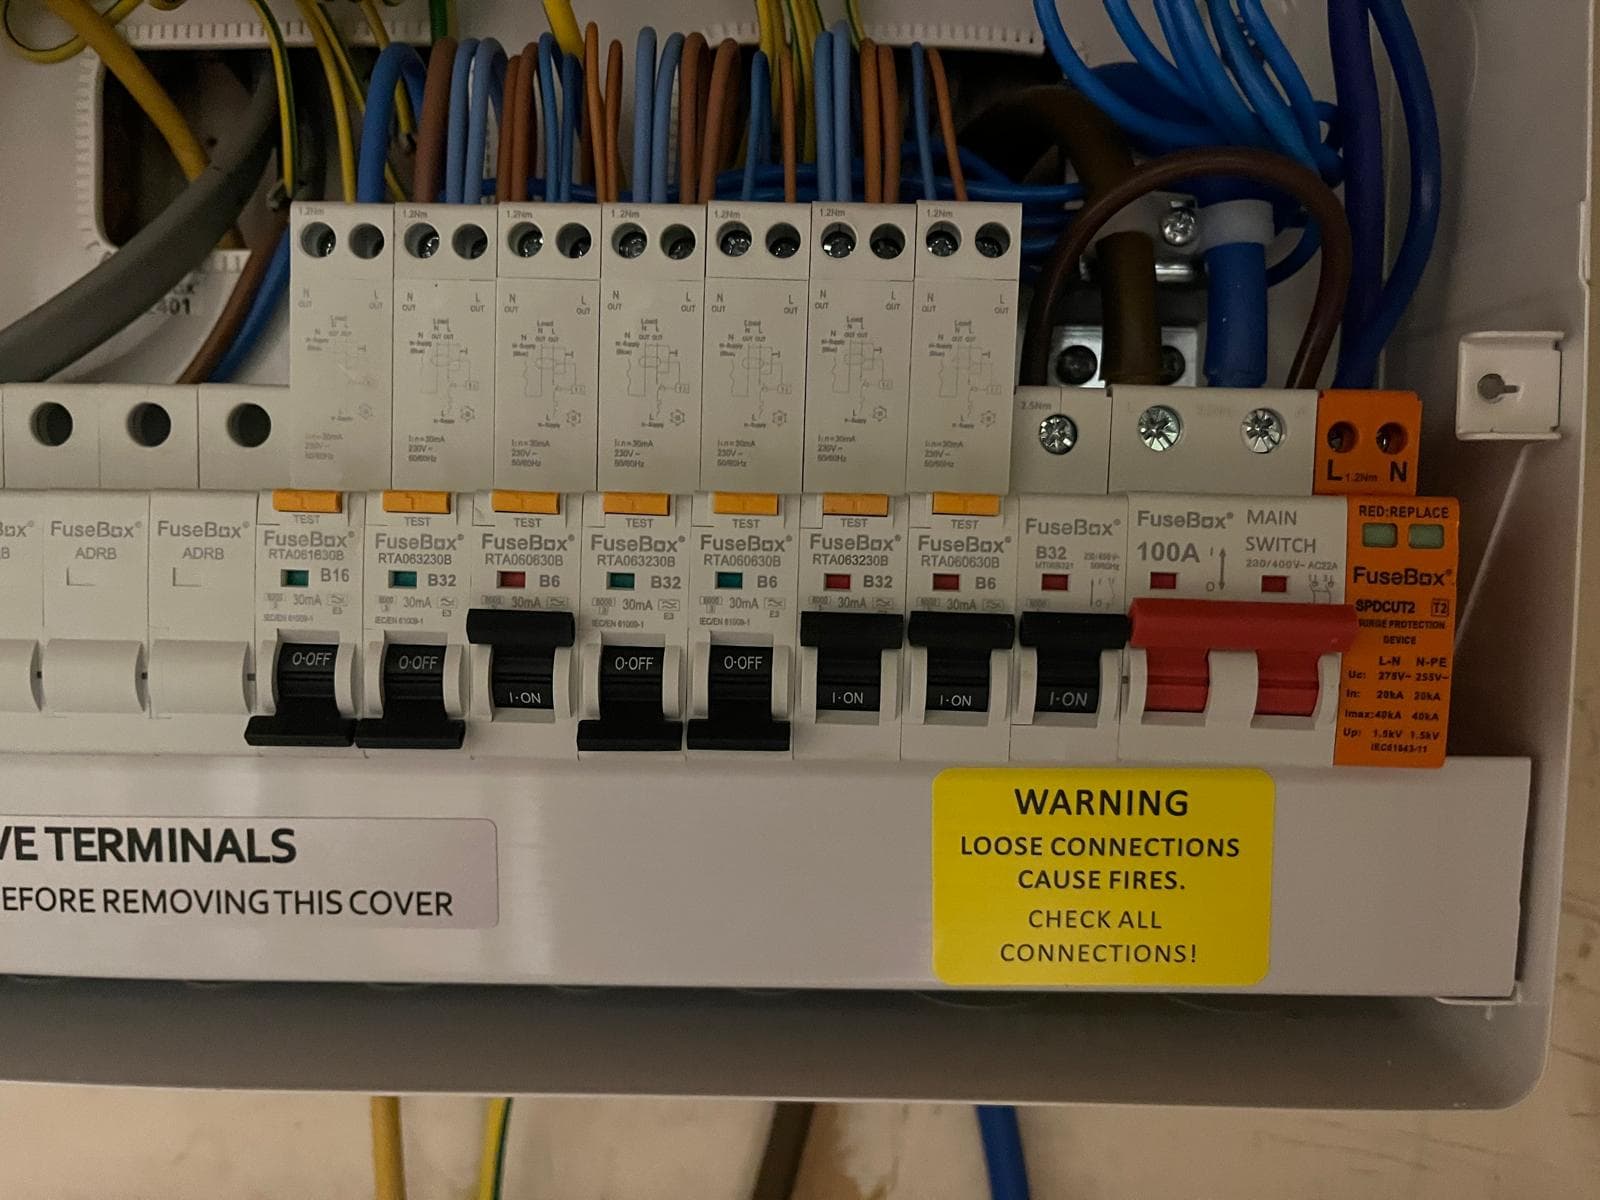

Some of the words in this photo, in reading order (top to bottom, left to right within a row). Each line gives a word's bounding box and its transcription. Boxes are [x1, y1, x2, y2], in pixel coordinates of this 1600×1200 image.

[613, 291, 620, 300] N
[686, 292, 691, 302] L
[717, 293, 724, 302] N
[788, 295, 794, 304] L
[402, 304, 416, 312] OUT
[470, 304, 485, 313] OUT
[504, 305, 519, 313] OUT
[577, 307, 591, 315] OUT
[607, 303, 622, 311] OUT
[681, 304, 696, 313] OUT
[711, 305, 726, 313] OUT
[784, 306, 798, 315] OUT
[815, 302, 829, 310] OUT
[886, 303, 900, 311] OUT
[922, 305, 936, 313] OUT
[995, 306, 1009, 315] OUT
[1327, 460, 1343, 481] L
[1390, 461, 1408, 482] N
[1247, 510, 1297, 525] MAIN
[1360, 505, 1449, 519] RED:REPLACE
[404, 517, 431, 526] TEST
[514, 518, 542, 528] TEST
[625, 518, 654, 528] TEST
[732, 519, 760, 528] TEST
[841, 518, 868, 528] TEST
[951, 519, 980, 530] TEST
[1246, 536, 1316, 553] SWITCH
[75, 547, 117, 559] ADRB
[182, 547, 225, 560] ADRB
[1036, 546, 1067, 559] B32
[1137, 542, 1200, 563] 100A
[597, 554, 675, 567] RTA063230B
[704, 554, 781, 567] RTA060630B
[812, 554, 889, 566] RTA063230B
[321, 569, 350, 582] B16
[428, 574, 457, 587] B32
[539, 574, 561, 588] B6
[651, 576, 681, 589] B32
[757, 576, 778, 589] B6
[863, 576, 893, 589] B32
[975, 577, 997, 590] B6
[403, 597, 432, 609] 30mA
[511, 597, 541, 609] 30mA
[622, 599, 653, 611] 30mA
[729, 598, 759, 609] 30mA
[838, 599, 867, 610] 30mA
[947, 600, 976, 611] 30mA
[1356, 599, 1415, 613] SPDCUT2
[1434, 603, 1447, 614] T2
[1389, 620, 1445, 629] PROTECTION
[1384, 636, 1416, 644] DEVICE
[1379, 656, 1400, 665] L-N
[1416, 657, 1447, 667] N-PE
[1377, 691, 1403, 699] 20kA
[1414, 692, 1440, 700] 20kA
[1375, 711, 1401, 719] 40kA
[1412, 712, 1439, 720] 40kA
[1344, 728, 1361, 737] Up:
[1373, 730, 1402, 738] 1.5kV
[1411, 731, 1439, 739] 1.5kV
[1015, 788, 1189, 816] WARNING
[44, 827, 297, 864] TERMINALS
[961, 836, 1043, 856] LOOSE
[1051, 837, 1240, 857] CONNECTIONS
[1018, 870, 1101, 889] CAUSE
[1109, 870, 1185, 890] FIRES.
[2, 886, 96, 913] EFORE
[103, 888, 269, 915] REMOVING
[274, 890, 343, 915] THIS
[350, 891, 453, 917] COVER
[1028, 909, 1111, 929] CHECK
[1119, 910, 1162, 929] ALL
[1000, 944, 1196, 963] CONNECTIONS!
